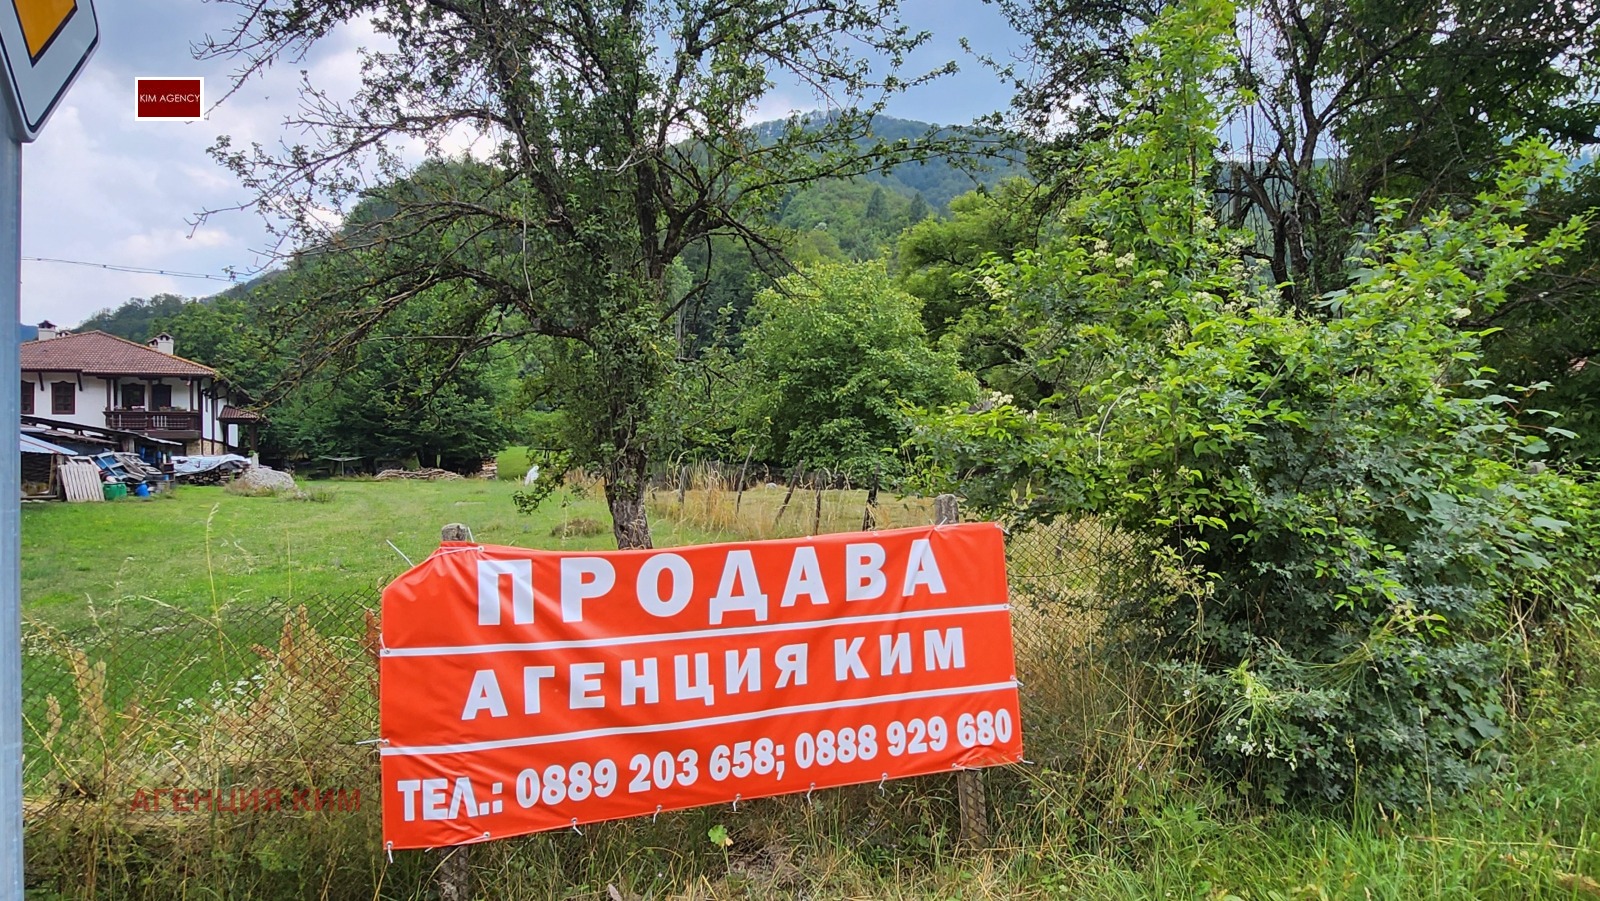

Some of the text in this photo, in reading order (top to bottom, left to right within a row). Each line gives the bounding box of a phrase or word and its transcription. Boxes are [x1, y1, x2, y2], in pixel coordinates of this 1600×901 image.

[476, 537, 947, 626] ПРОДАВА
[461, 627, 966, 721] АГЕНЦИЯ КИМ
[397, 708, 1013, 822] ТЕЛ.: 0889 203 658; 0888 929 680
